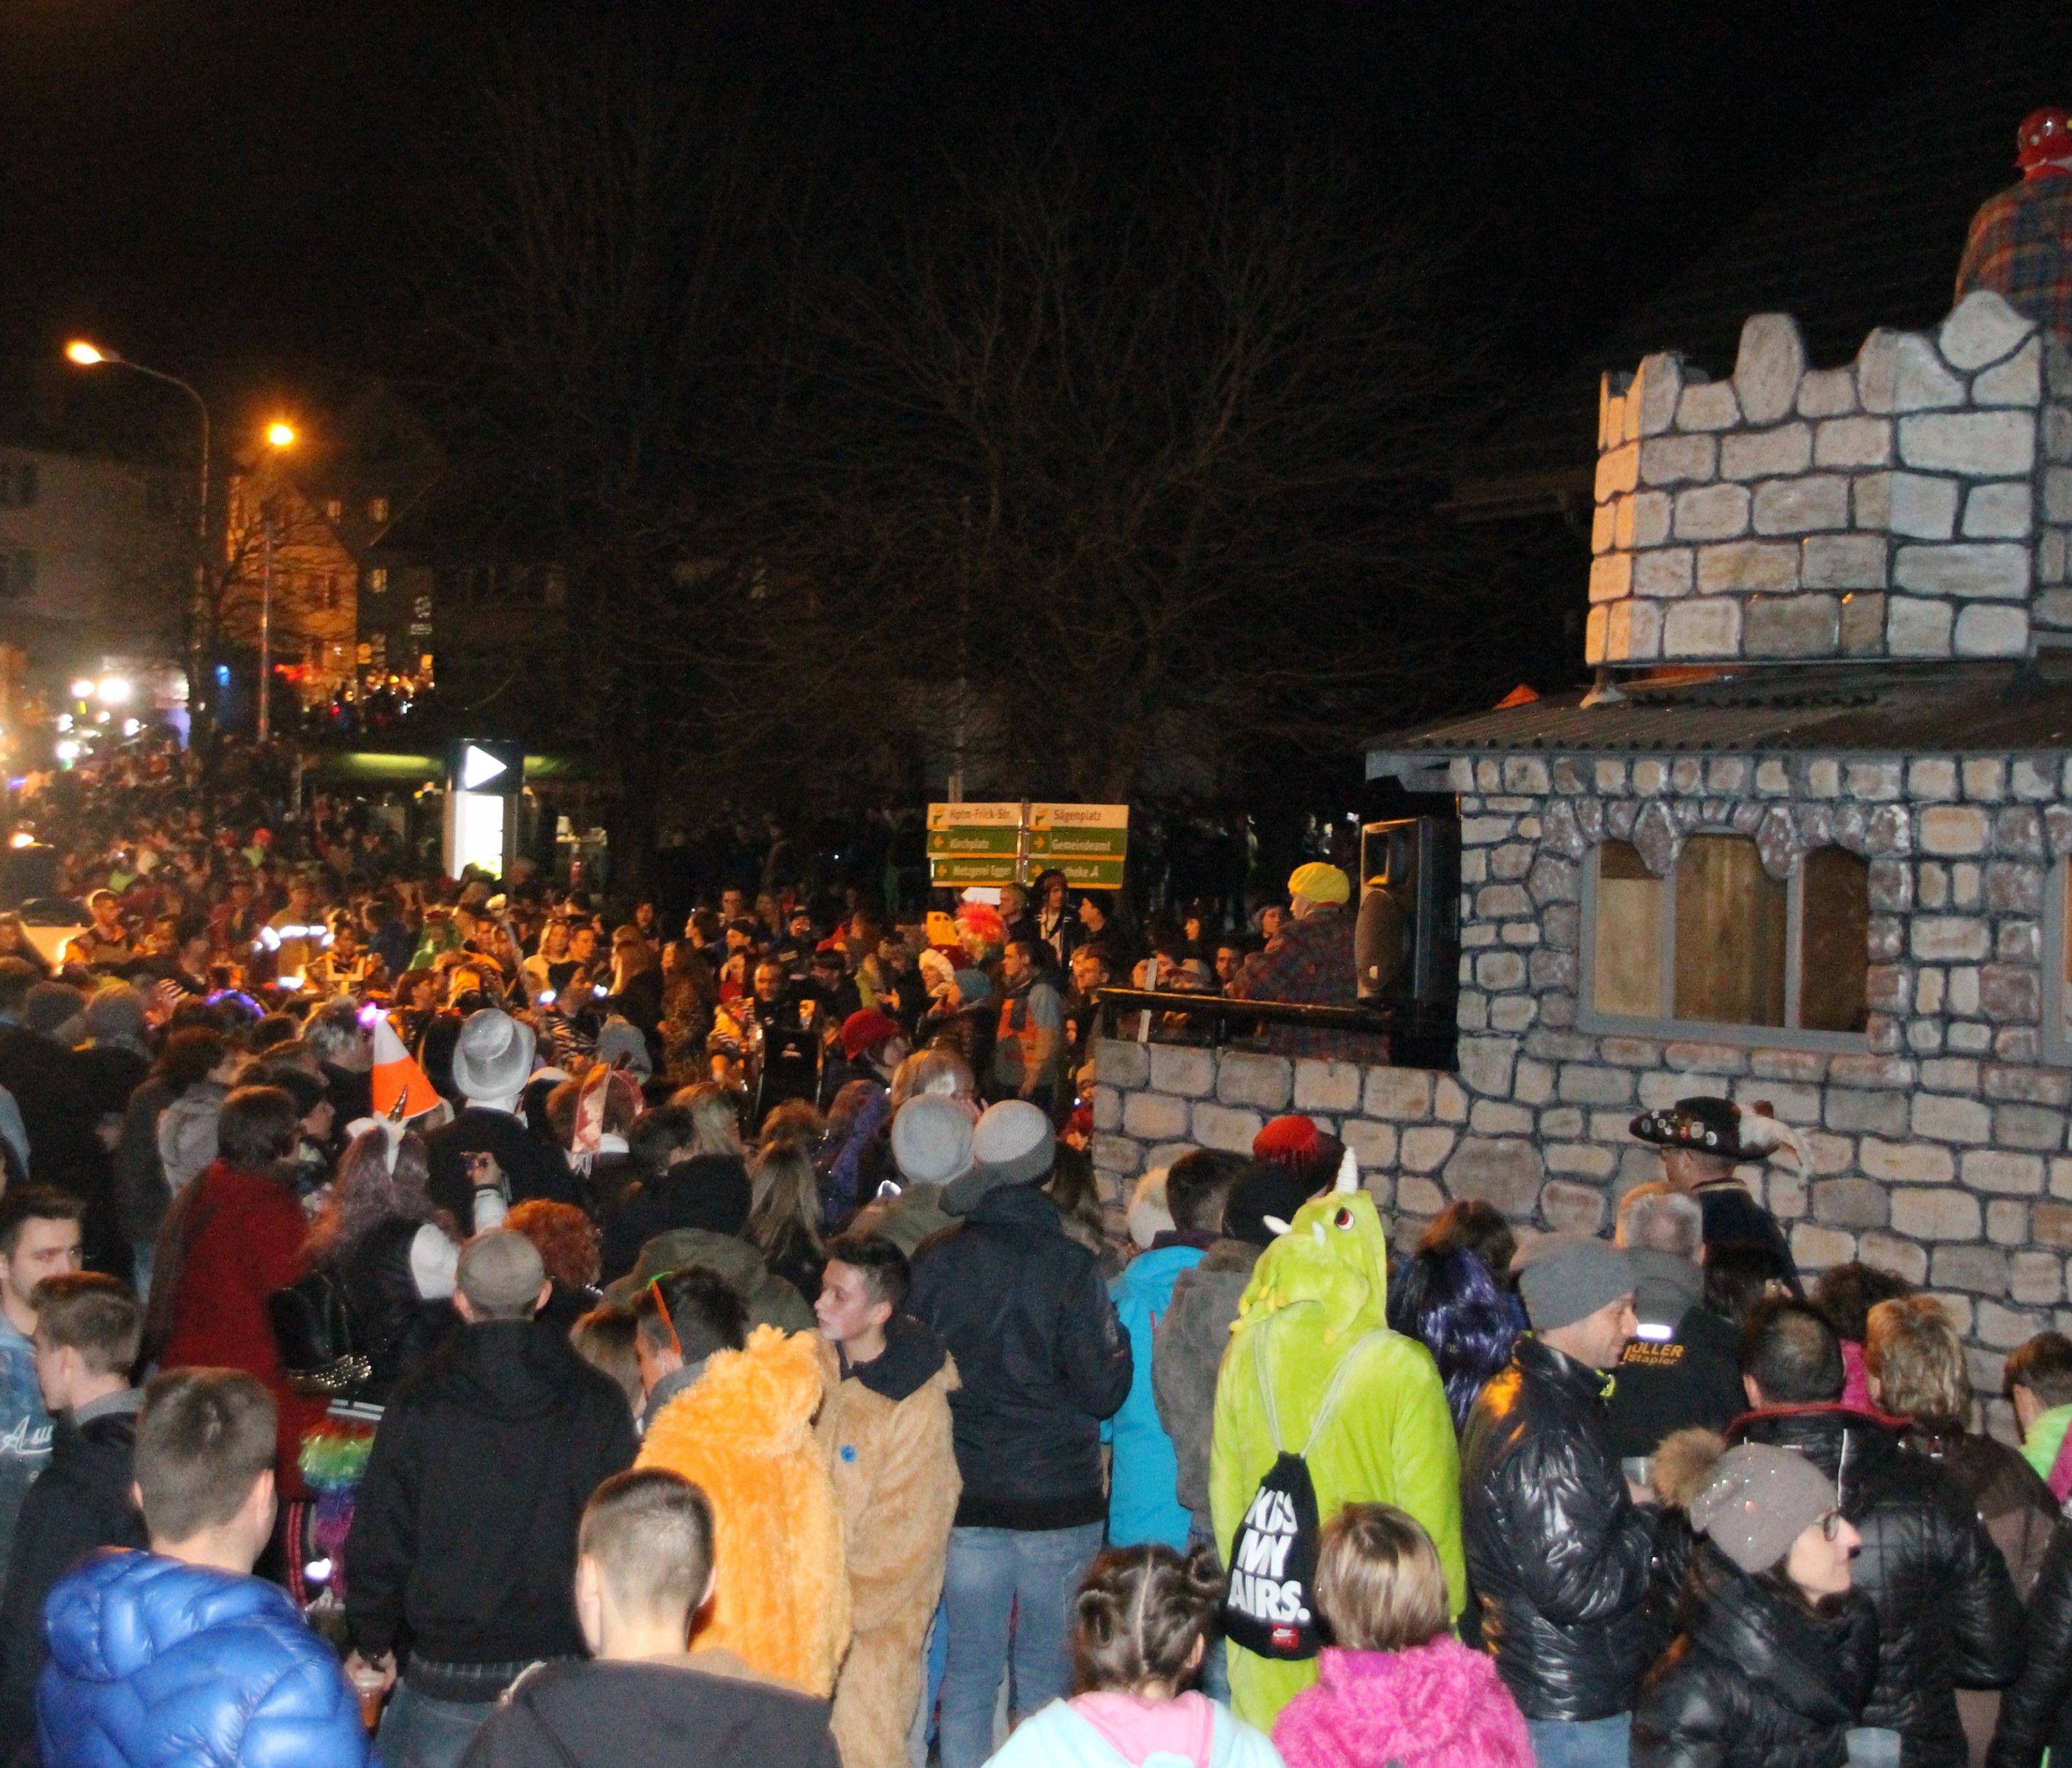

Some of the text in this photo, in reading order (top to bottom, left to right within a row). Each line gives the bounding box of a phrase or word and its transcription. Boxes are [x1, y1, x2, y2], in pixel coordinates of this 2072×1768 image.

[1053, 809, 1102, 822] Sägenplatz
[1052, 838, 1111, 851] Gemeindeamt
[1237, 1528, 1292, 1577] MY
[1228, 1569, 1311, 1623] AIRS.
